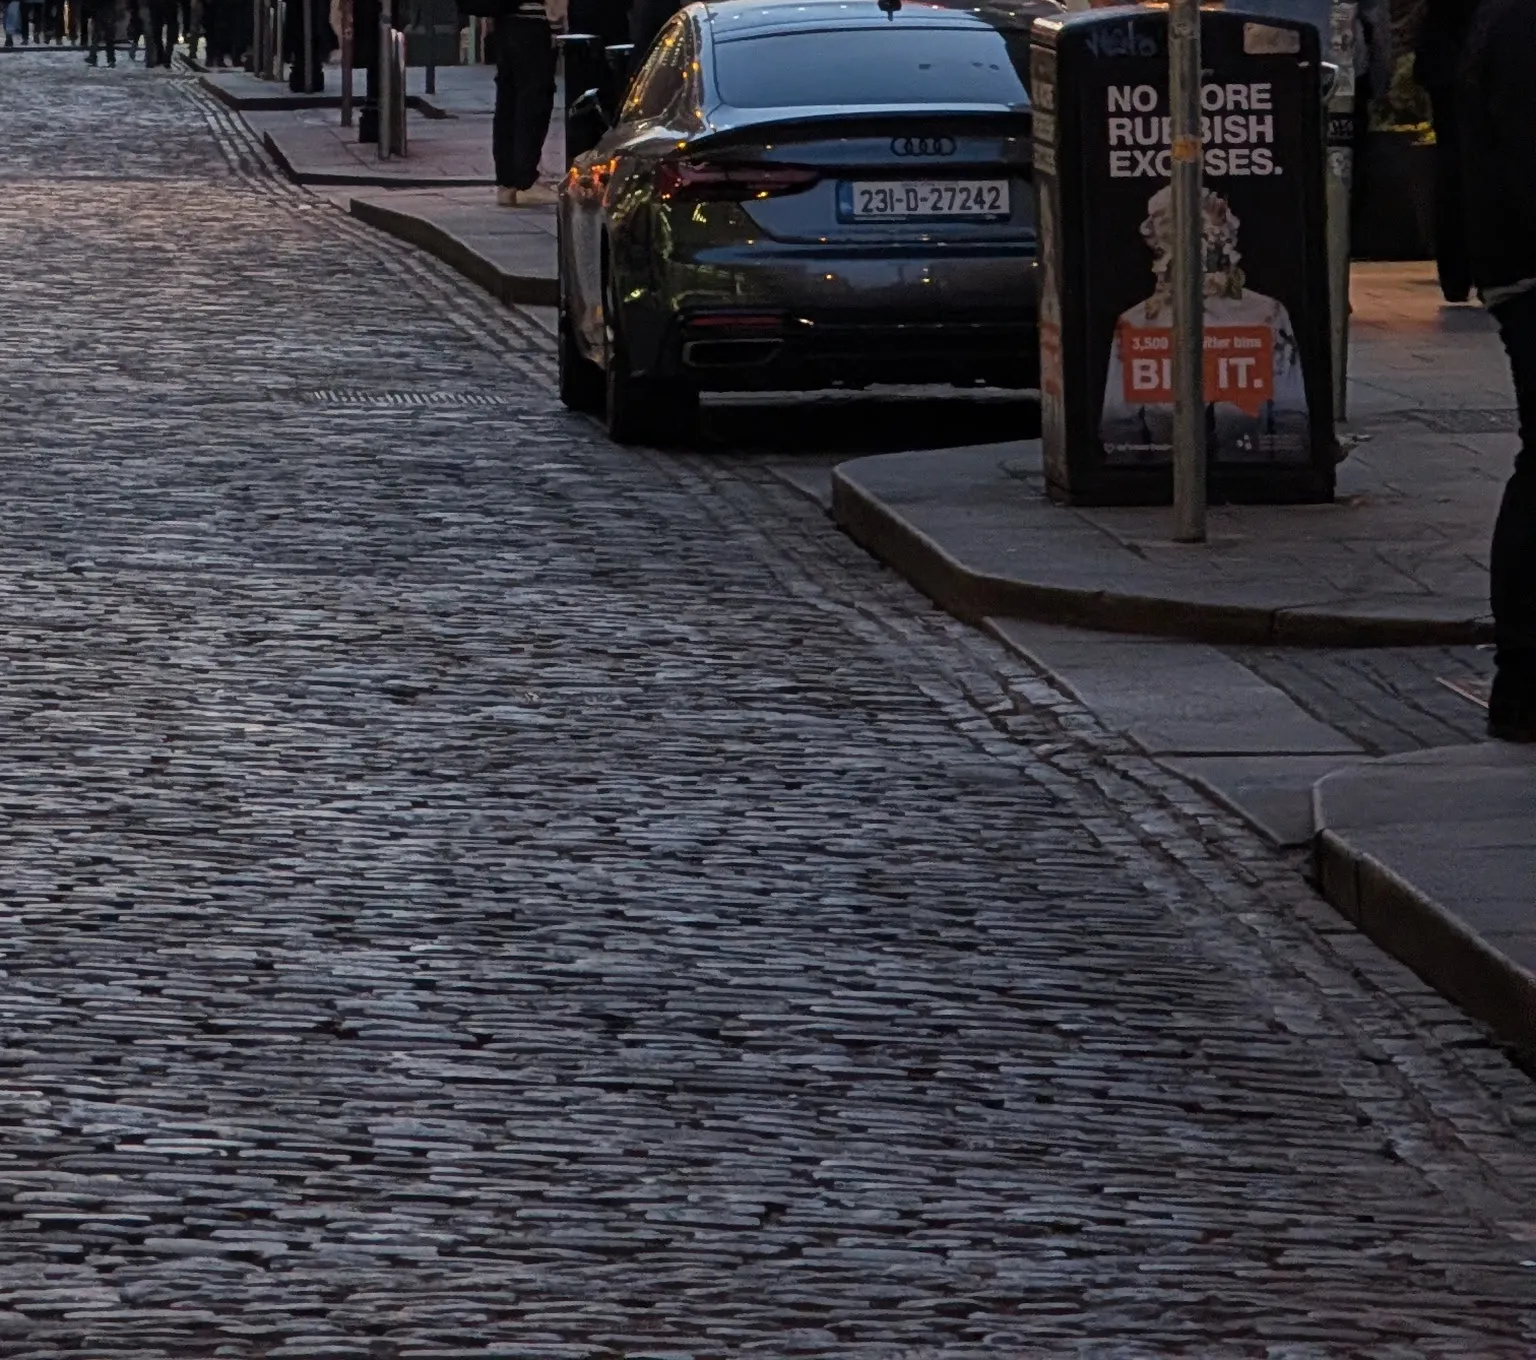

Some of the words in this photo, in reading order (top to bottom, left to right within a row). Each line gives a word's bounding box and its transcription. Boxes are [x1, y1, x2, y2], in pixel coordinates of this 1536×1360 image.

[1107, 84, 1158, 113] NO
[1199, 83, 1273, 111] ORE
[1109, 147, 1284, 178] EXCSES.
[859, 186, 1001, 214] 231-D-27242
[1131, 336, 1170, 351] 3,500
[1233, 335, 1262, 349] bins
[1131, 357, 1172, 391] BI
[1217, 356, 1265, 390] IT.
